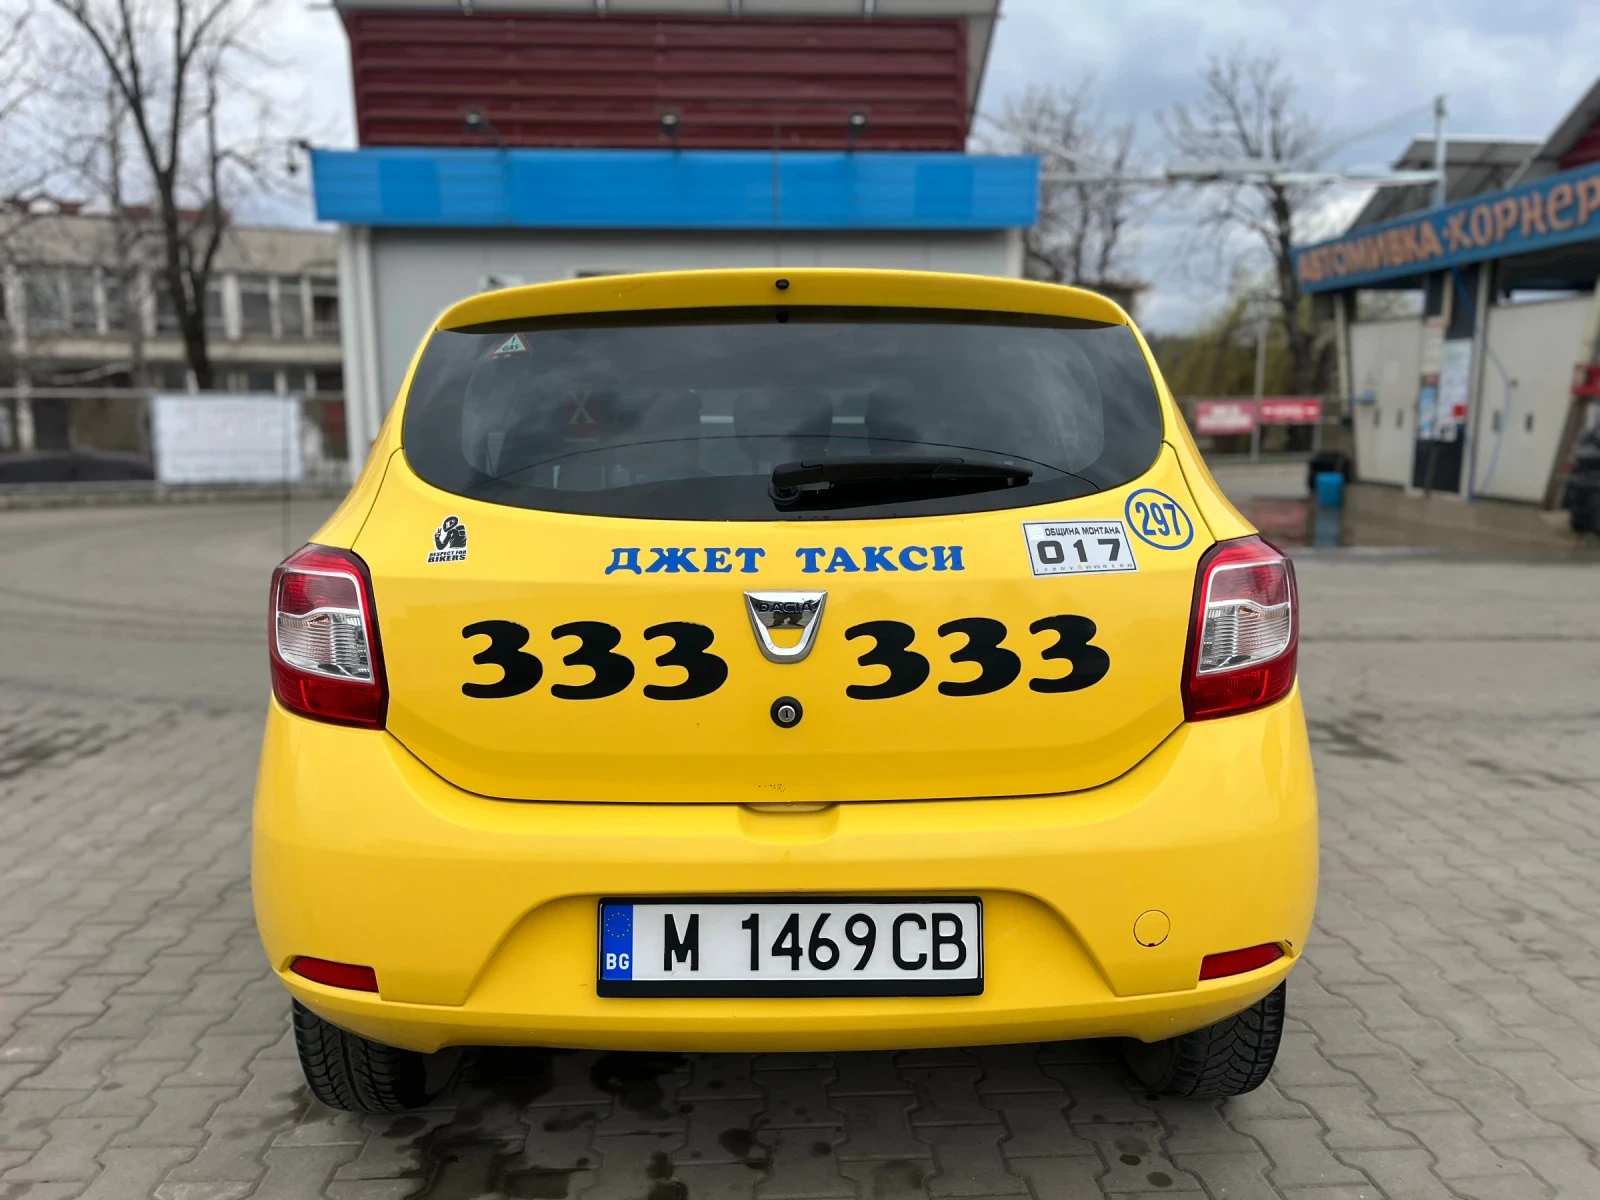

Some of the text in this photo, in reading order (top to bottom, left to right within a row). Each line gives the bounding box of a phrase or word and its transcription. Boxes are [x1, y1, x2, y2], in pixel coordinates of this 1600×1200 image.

[1298, 220, 1444, 282] АВТОМИВКА
[1044, 526, 1121, 536] ОБЩИНА МОНТАНА
[1135, 501, 1182, 536] 297
[605, 545, 965, 575] ДЖЕТ ТАКСИ
[1037, 539, 1121, 565] 017
[759, 602, 813, 612] DACIA
[462, 614, 1110, 701] 333 333
[663, 913, 967, 971] M 1469 CB
[606, 953, 630, 970] BG
